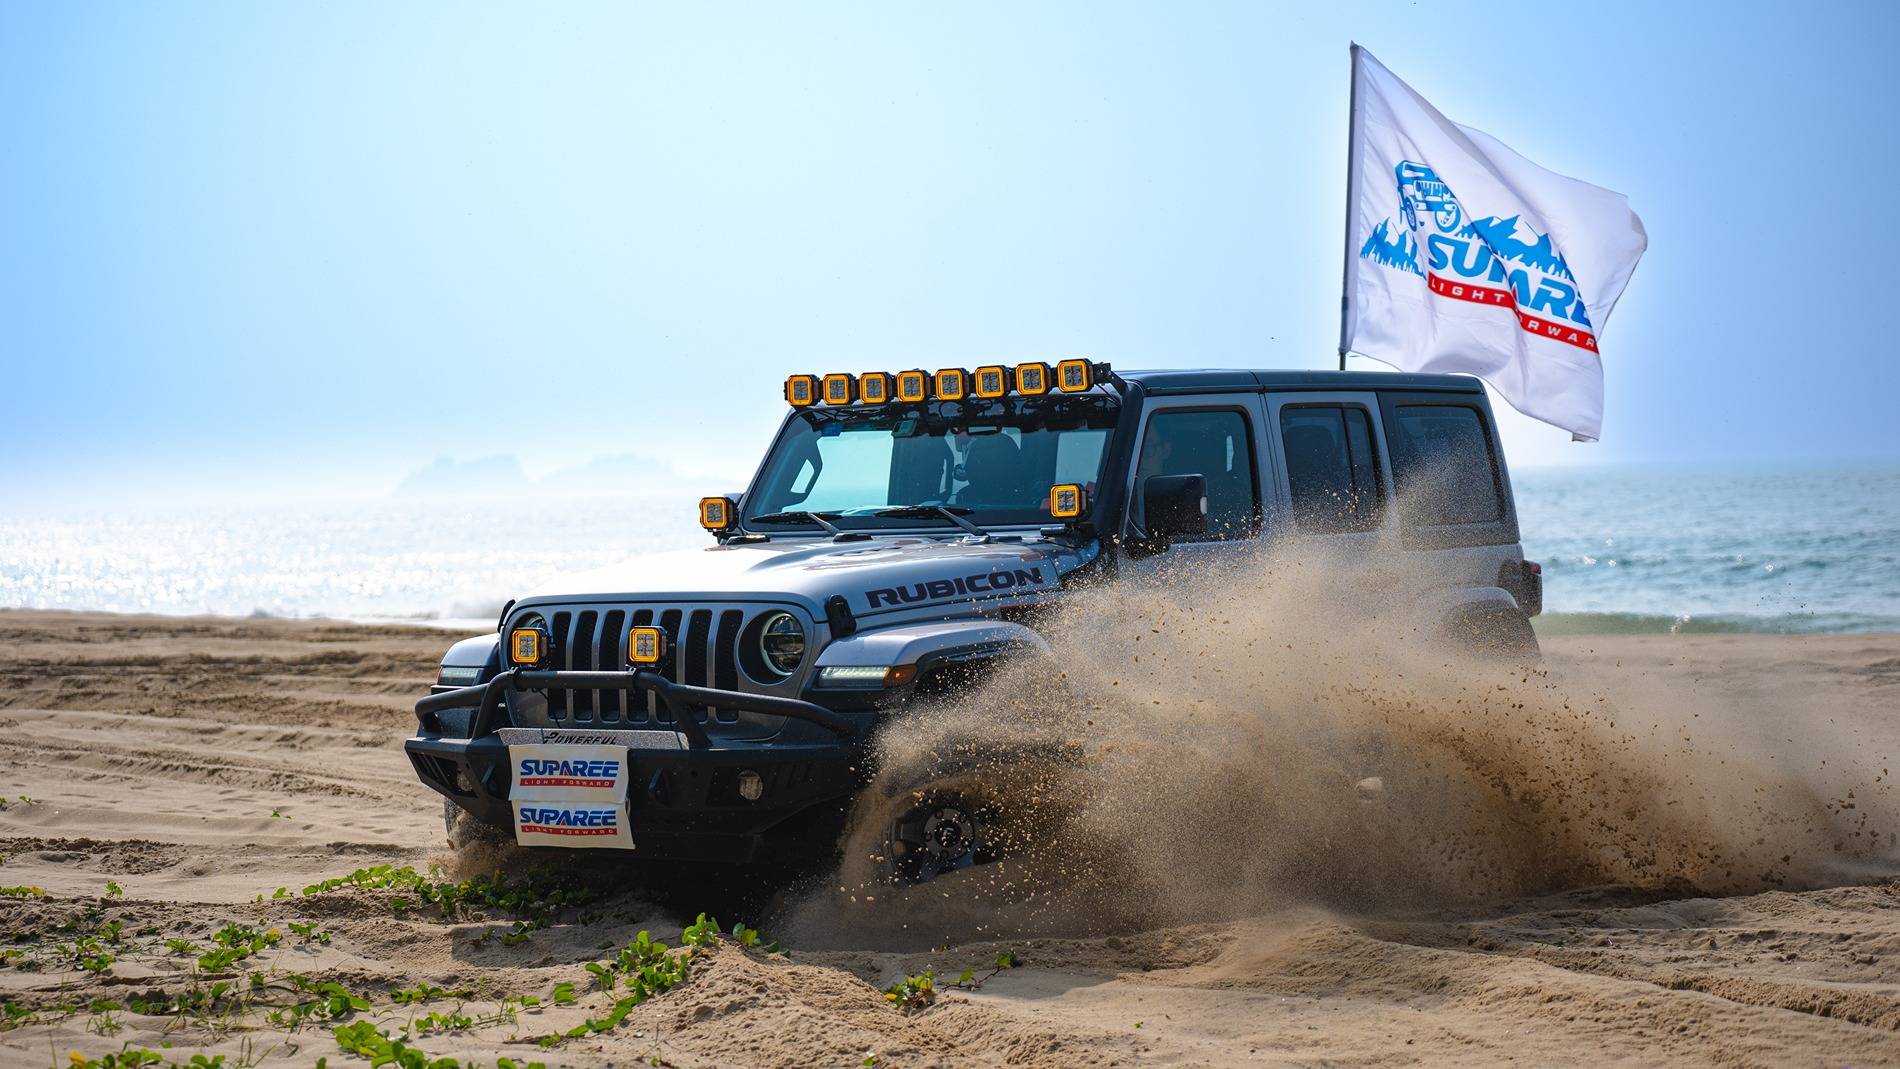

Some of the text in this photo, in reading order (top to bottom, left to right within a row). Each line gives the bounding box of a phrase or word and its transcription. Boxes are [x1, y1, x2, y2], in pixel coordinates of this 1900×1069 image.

[1431, 279, 1596, 347] LIGHT RWAR
[865, 567, 1043, 608] RUBICON
[543, 732, 618, 745] POWERFUL
[520, 759, 619, 777] SUPAREE
[520, 808, 616, 826] SUPAREE
